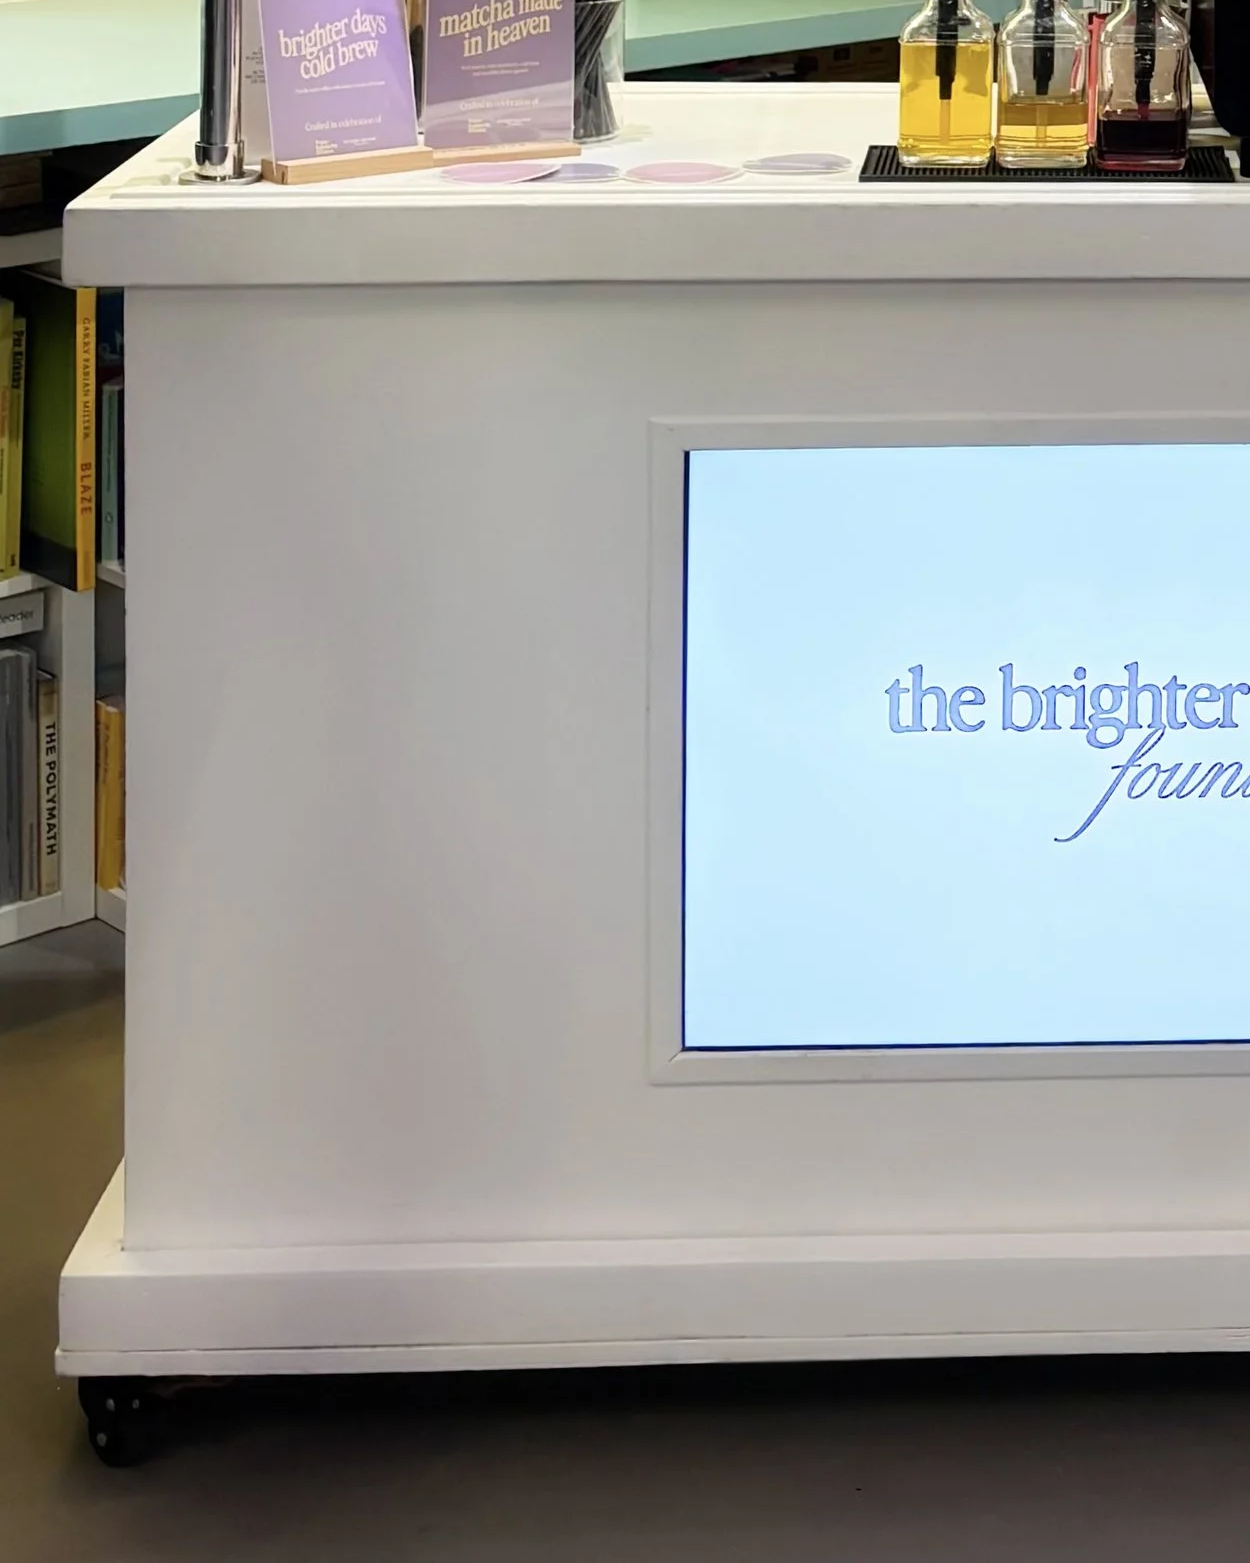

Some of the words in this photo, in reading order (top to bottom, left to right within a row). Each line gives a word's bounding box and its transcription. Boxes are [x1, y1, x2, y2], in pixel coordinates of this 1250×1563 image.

[278, 15, 350, 60] brighter
[351, 7, 387, 38] days
[463, 31, 483, 58] in
[486, 14, 550, 53] heaven
[300, 46, 335, 79] cold
[338, 39, 379, 65] brew
[80, 461, 92, 515] BLAZE
[0, 608, 34, 624] eader
[885, 663, 986, 734] the
[999, 661, 1250, 749] brighter
[45, 722, 57, 756] THE
[45, 761, 57, 857] POLYMATH
